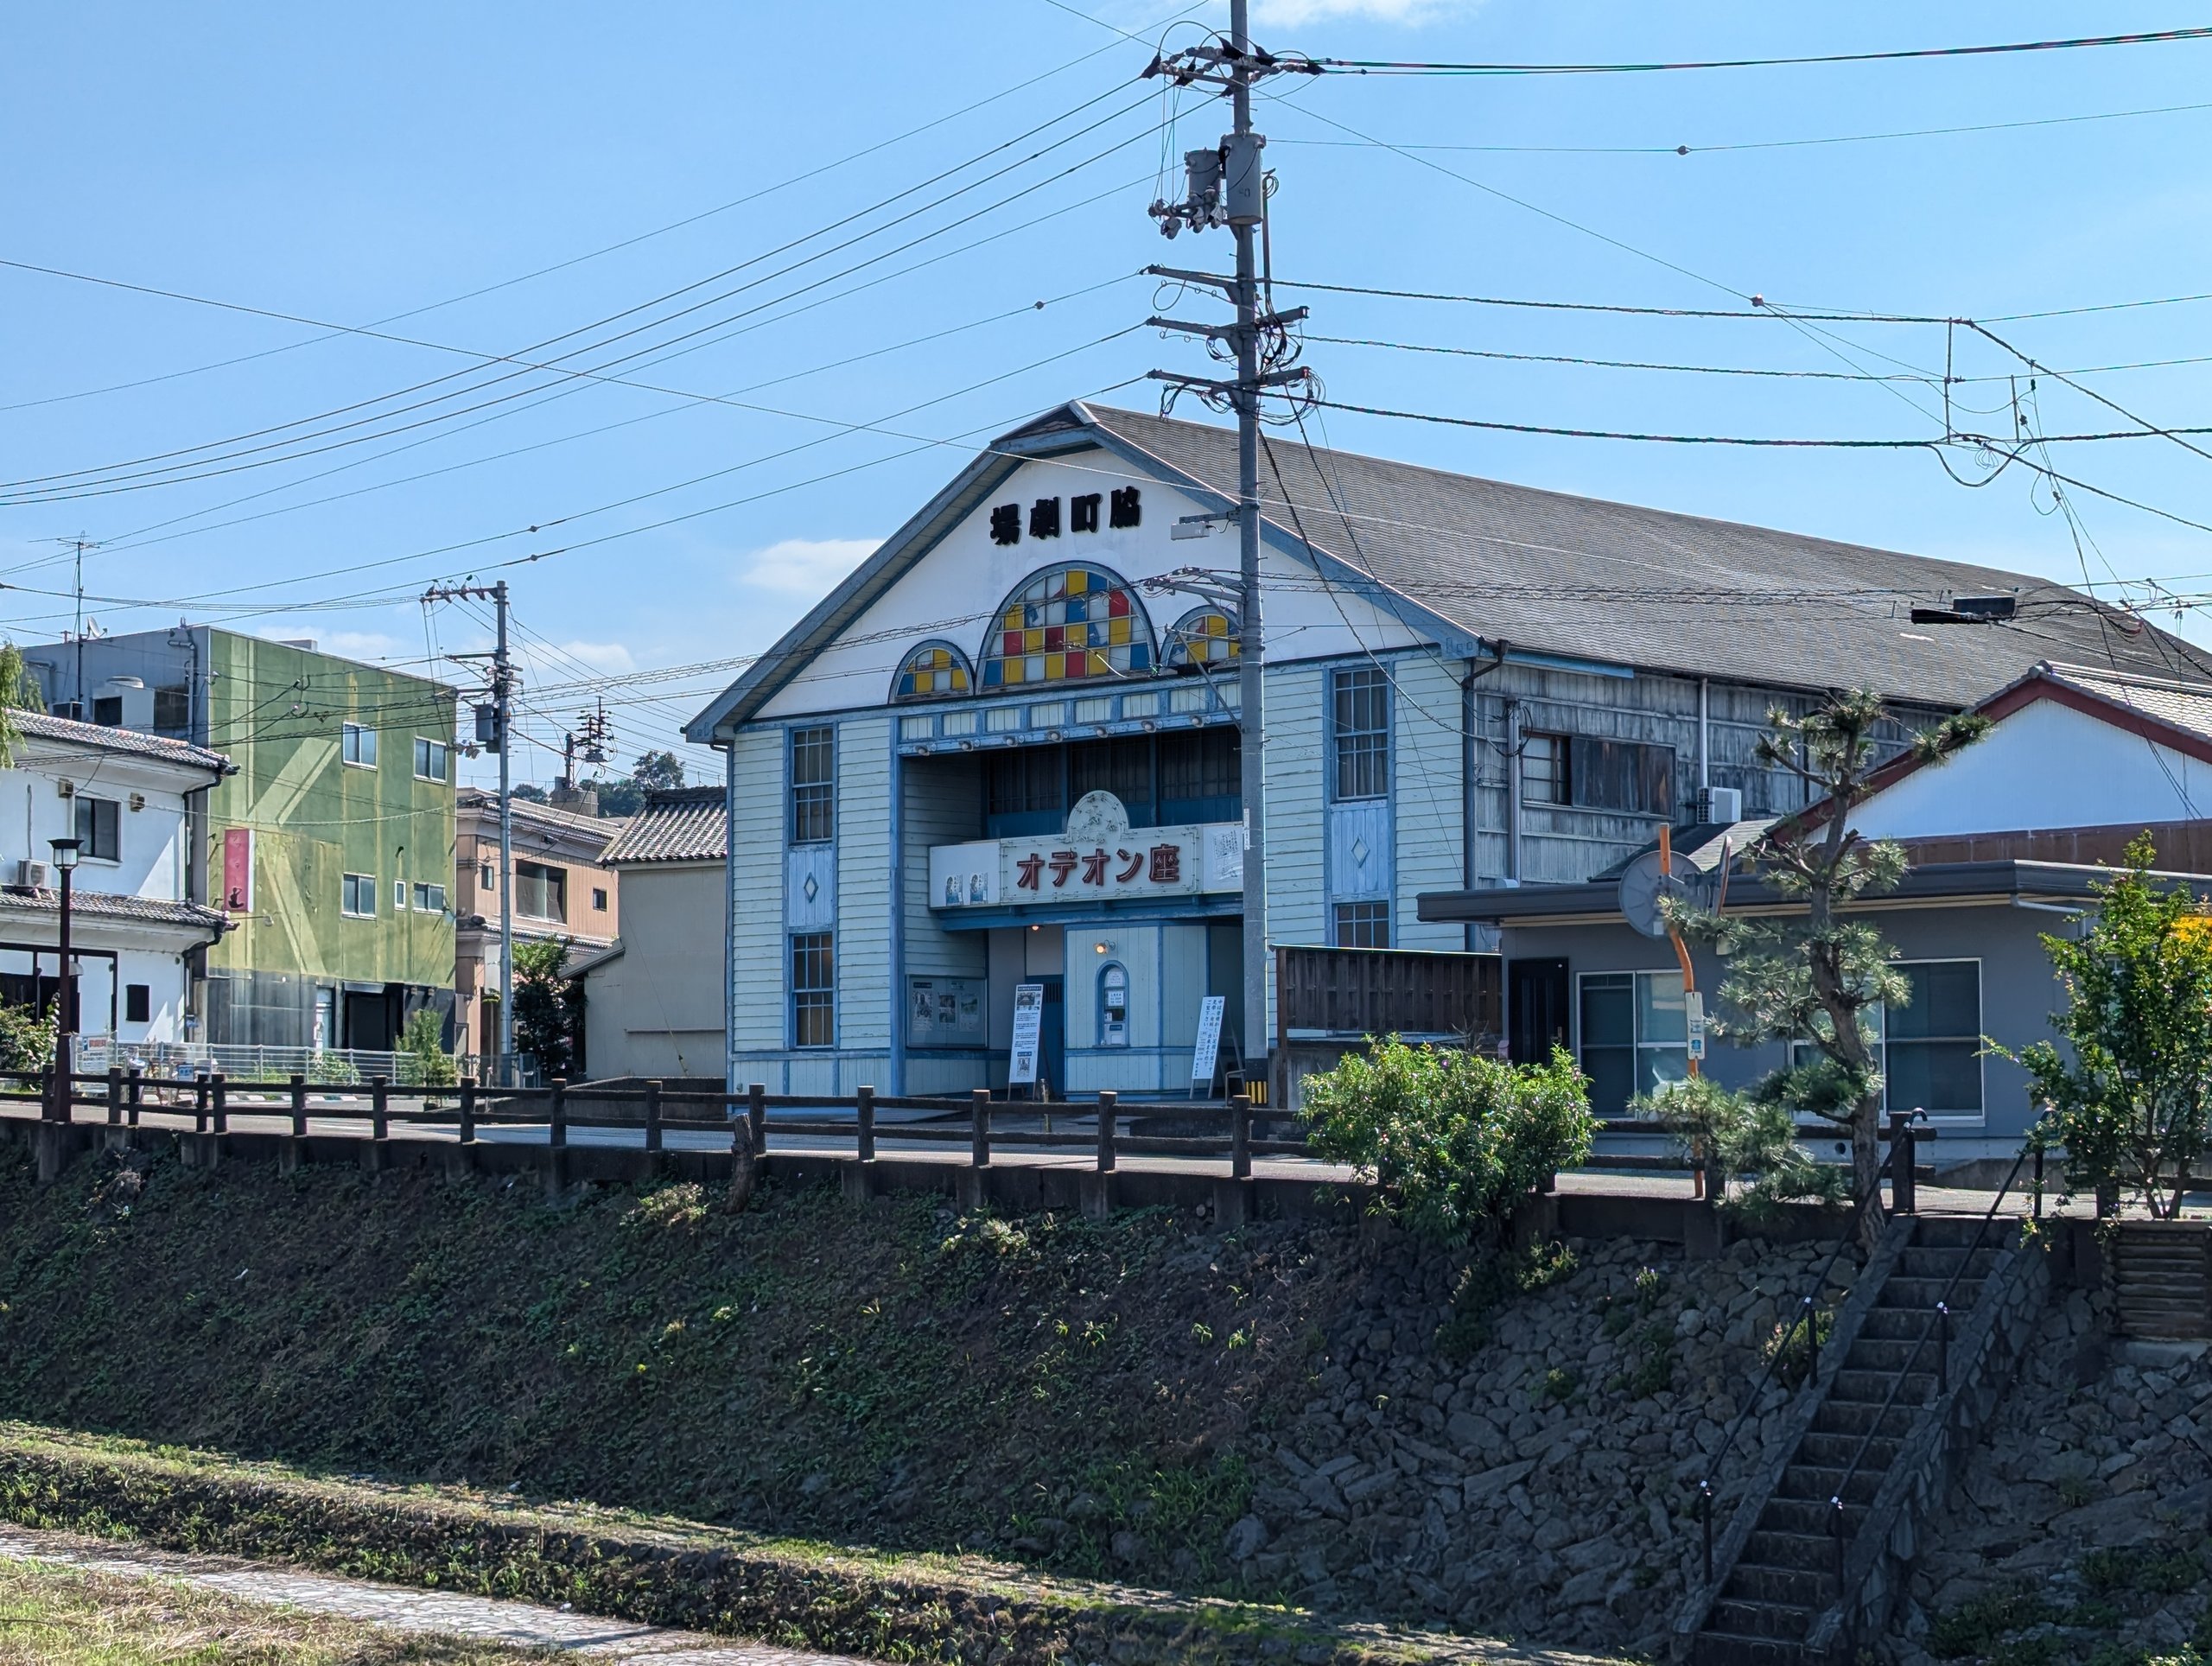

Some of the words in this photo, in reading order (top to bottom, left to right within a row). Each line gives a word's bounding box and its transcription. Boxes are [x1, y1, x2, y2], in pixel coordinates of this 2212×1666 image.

[1016, 843, 1180, 889] オデオン座
